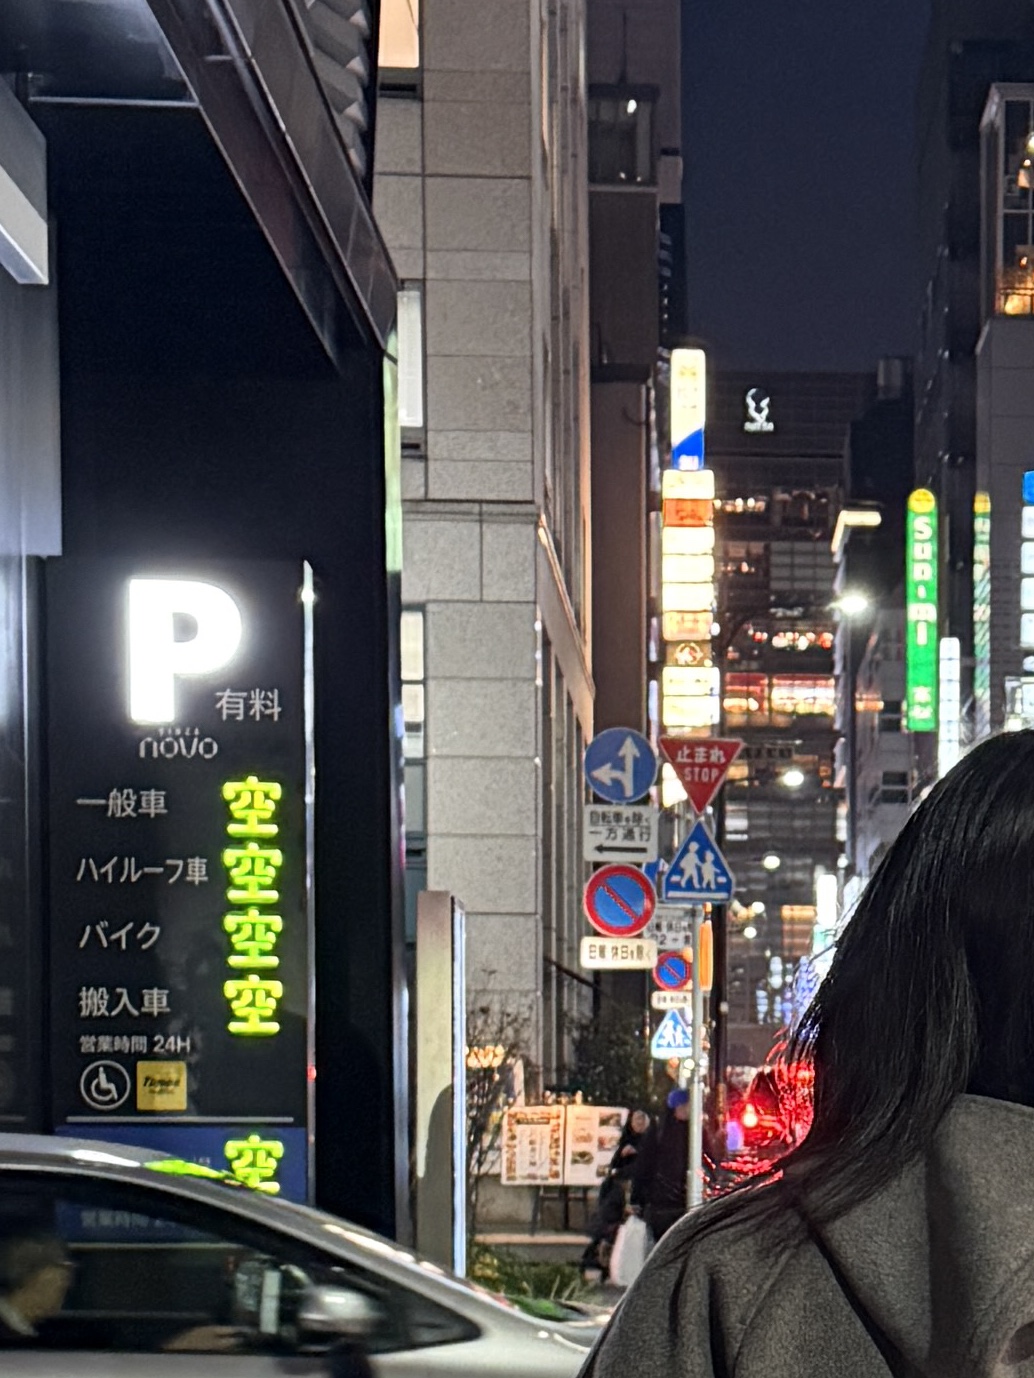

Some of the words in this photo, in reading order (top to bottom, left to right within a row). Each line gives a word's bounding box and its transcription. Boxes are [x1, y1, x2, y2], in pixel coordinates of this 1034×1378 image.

[129, 579, 242, 723] P
[215, 688, 282, 721] 有料
[139, 737, 218, 759] novo
[676, 745, 727, 763] 止まれ
[684, 768, 720, 782] STOP
[76, 788, 168, 818] 一般車
[222, 776, 282, 838] 空
[590, 810, 650, 826] 自転車を除く
[589, 826, 651, 842] 一方通行
[76, 856, 209, 885] ハイルーフ車
[222, 842, 283, 904] 空
[79, 922, 161, 951] バイク
[222, 908, 283, 969] 空
[78, 987, 171, 1018] 搬入車
[223, 974, 283, 1036] 空
[80, 1035, 148, 1054] 営業時間
[153, 1034, 191, 1053] 24H
[224, 1135, 284, 1194] 空
